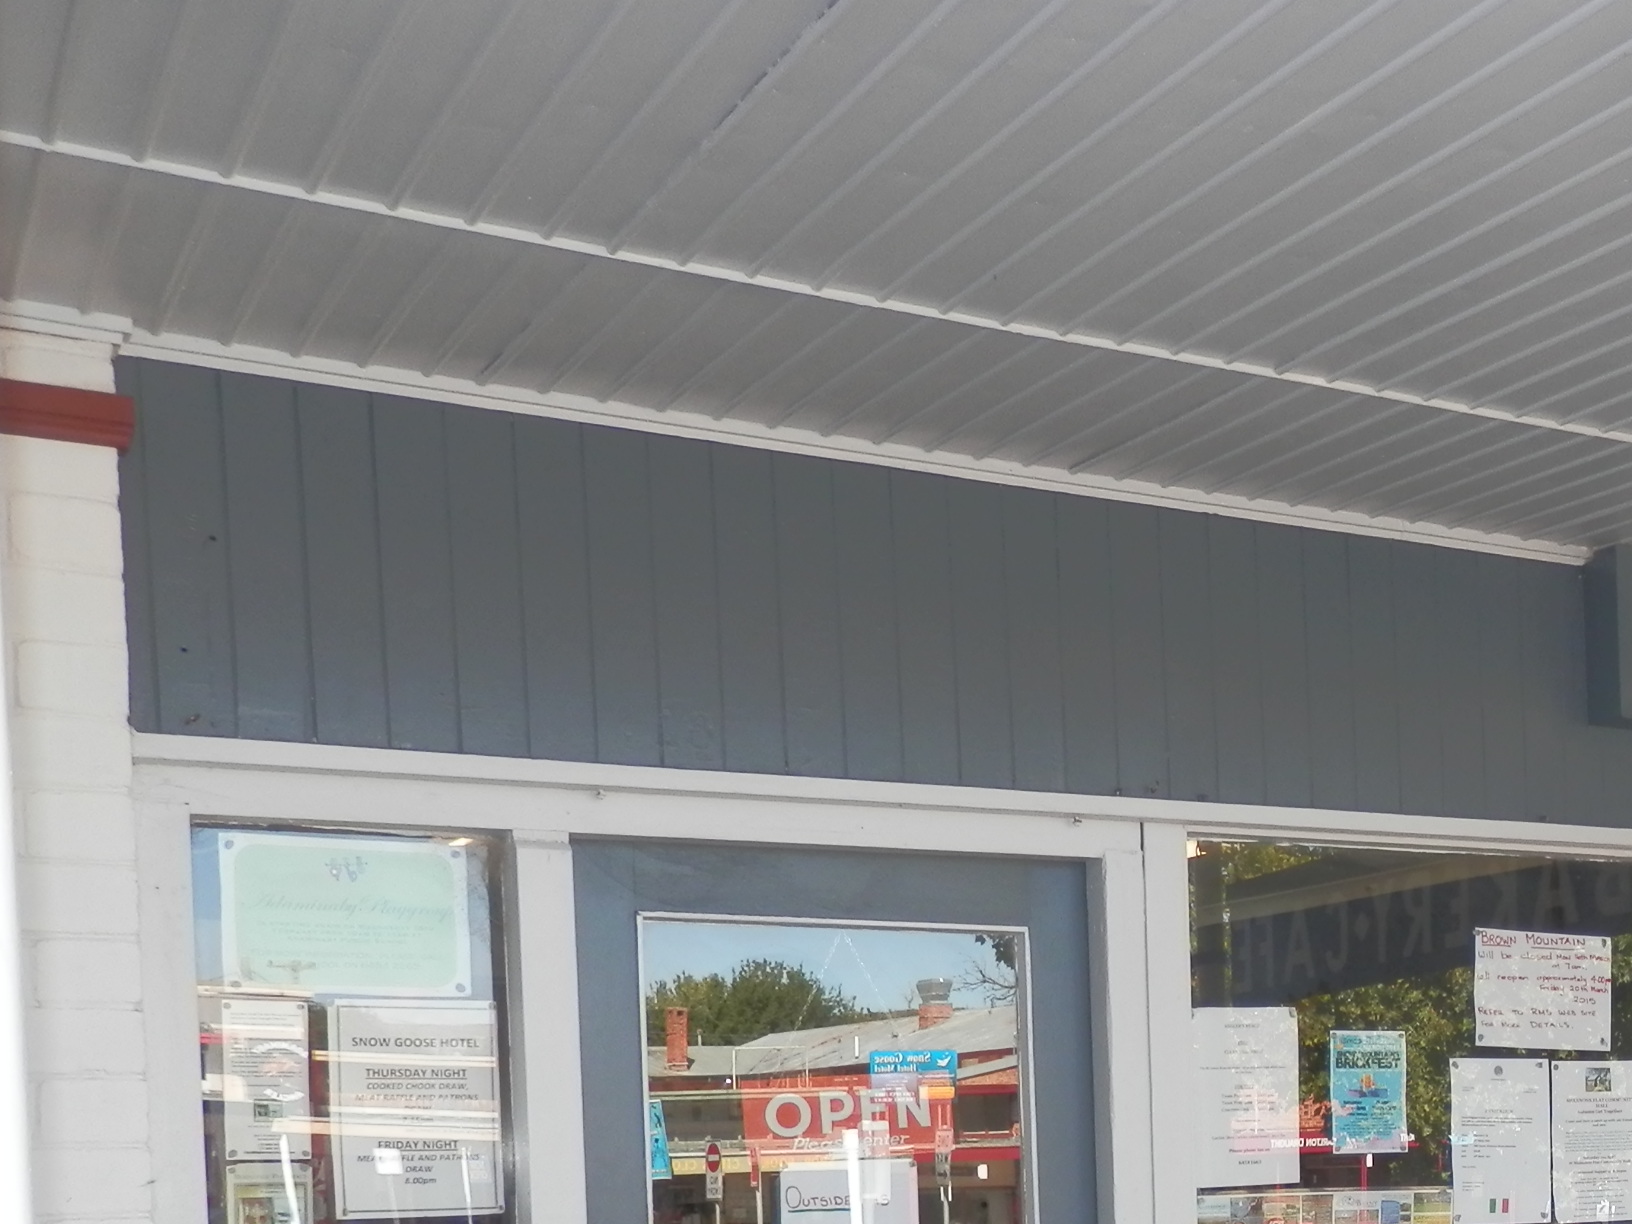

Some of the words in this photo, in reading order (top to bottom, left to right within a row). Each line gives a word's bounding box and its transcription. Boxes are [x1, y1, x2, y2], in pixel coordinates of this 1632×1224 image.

[1480, 930, 1517, 945] BROWN
[1526, 933, 1586, 947] MOUNTAIN
[351, 1036, 391, 1047] SNOW
[394, 1037, 437, 1048] GOOSE
[440, 1038, 480, 1048] HOTEL
[365, 1068, 428, 1078] THURSDAY
[430, 1068, 468, 1078] NIGHT
[366, 1082, 404, 1090] COOKED
[405, 1082, 437, 1090] CHOOK
[764, 1086, 933, 1138] OPEN
[377, 1140, 424, 1149] FRIDAY
[427, 1140, 459, 1149] NIGHT
[792, 1137, 850, 1150] Pleas
